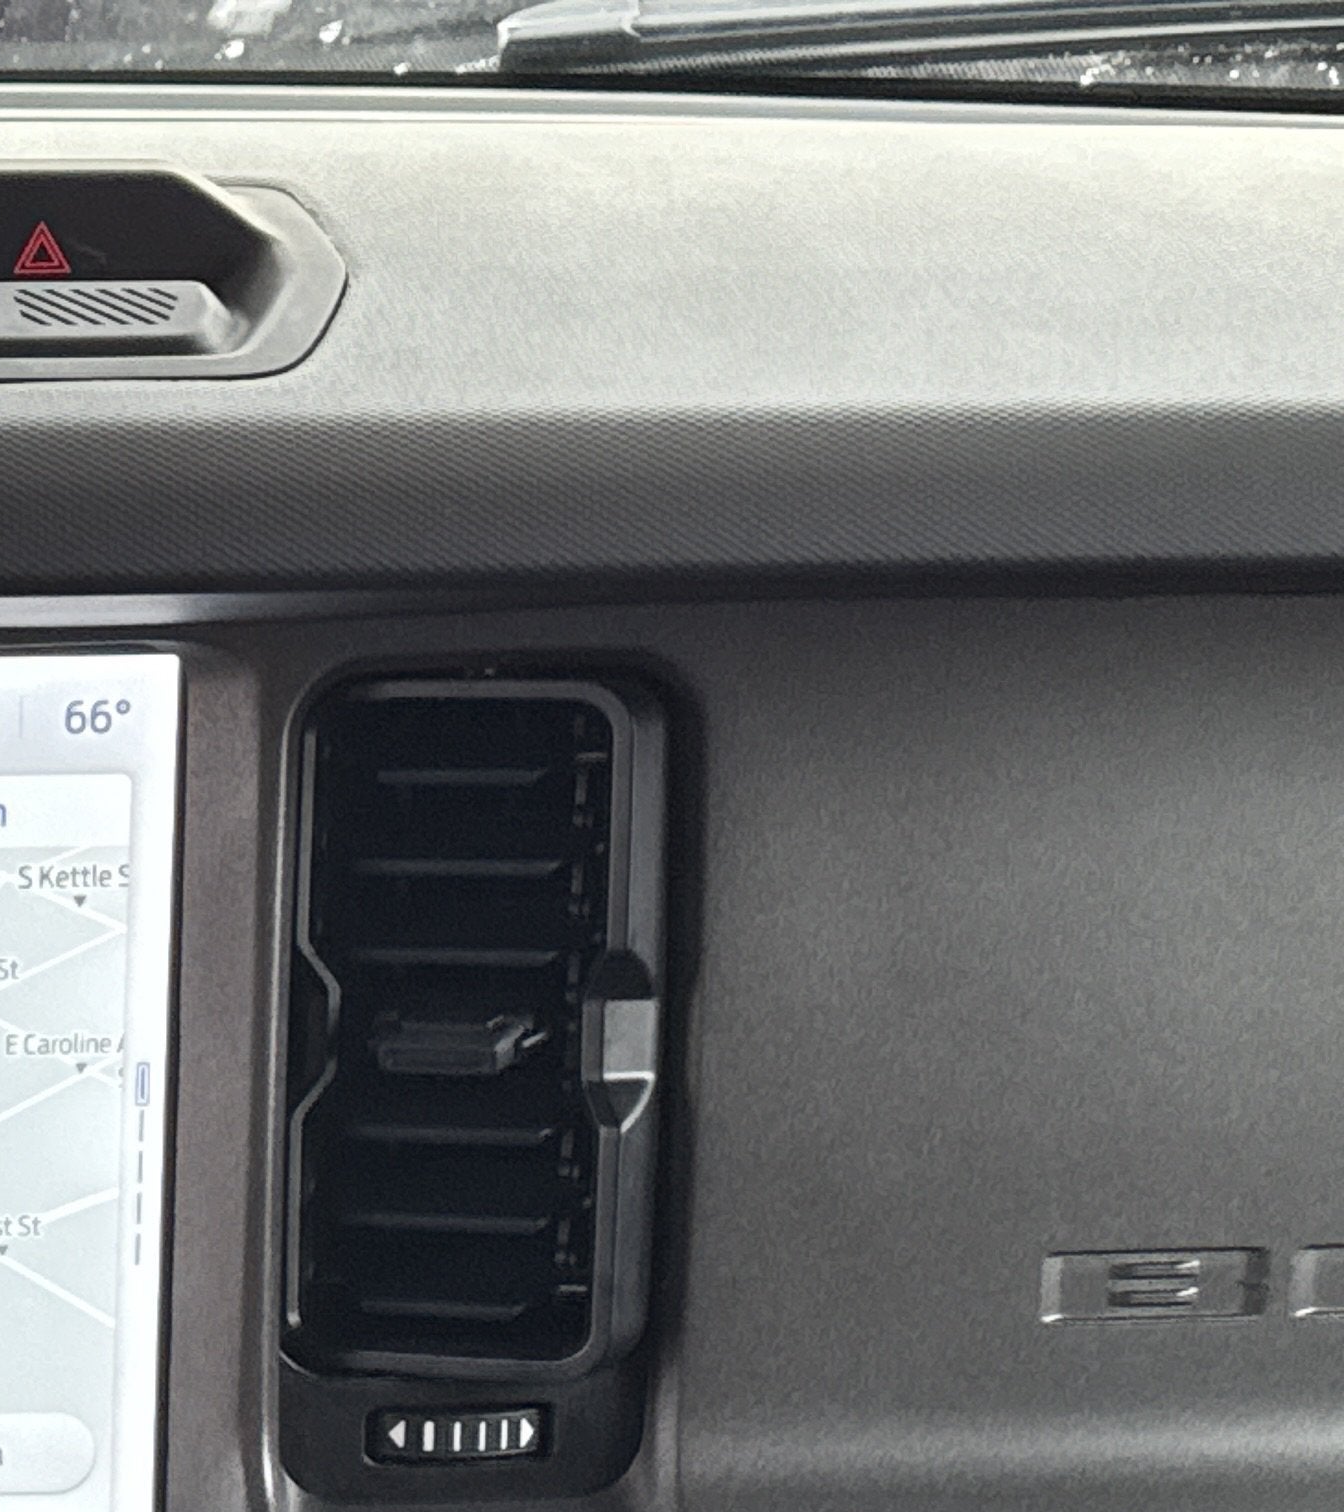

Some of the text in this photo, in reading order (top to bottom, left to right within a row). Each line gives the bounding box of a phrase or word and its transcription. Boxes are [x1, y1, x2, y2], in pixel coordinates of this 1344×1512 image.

[65, 700, 132, 735] 66°
[18, 866, 33, 889] S
[39, 864, 112, 888] Kettle
[6, 1034, 19, 1055] E
[24, 1033, 112, 1055] Caroline
[17, 1215, 41, 1237] St
